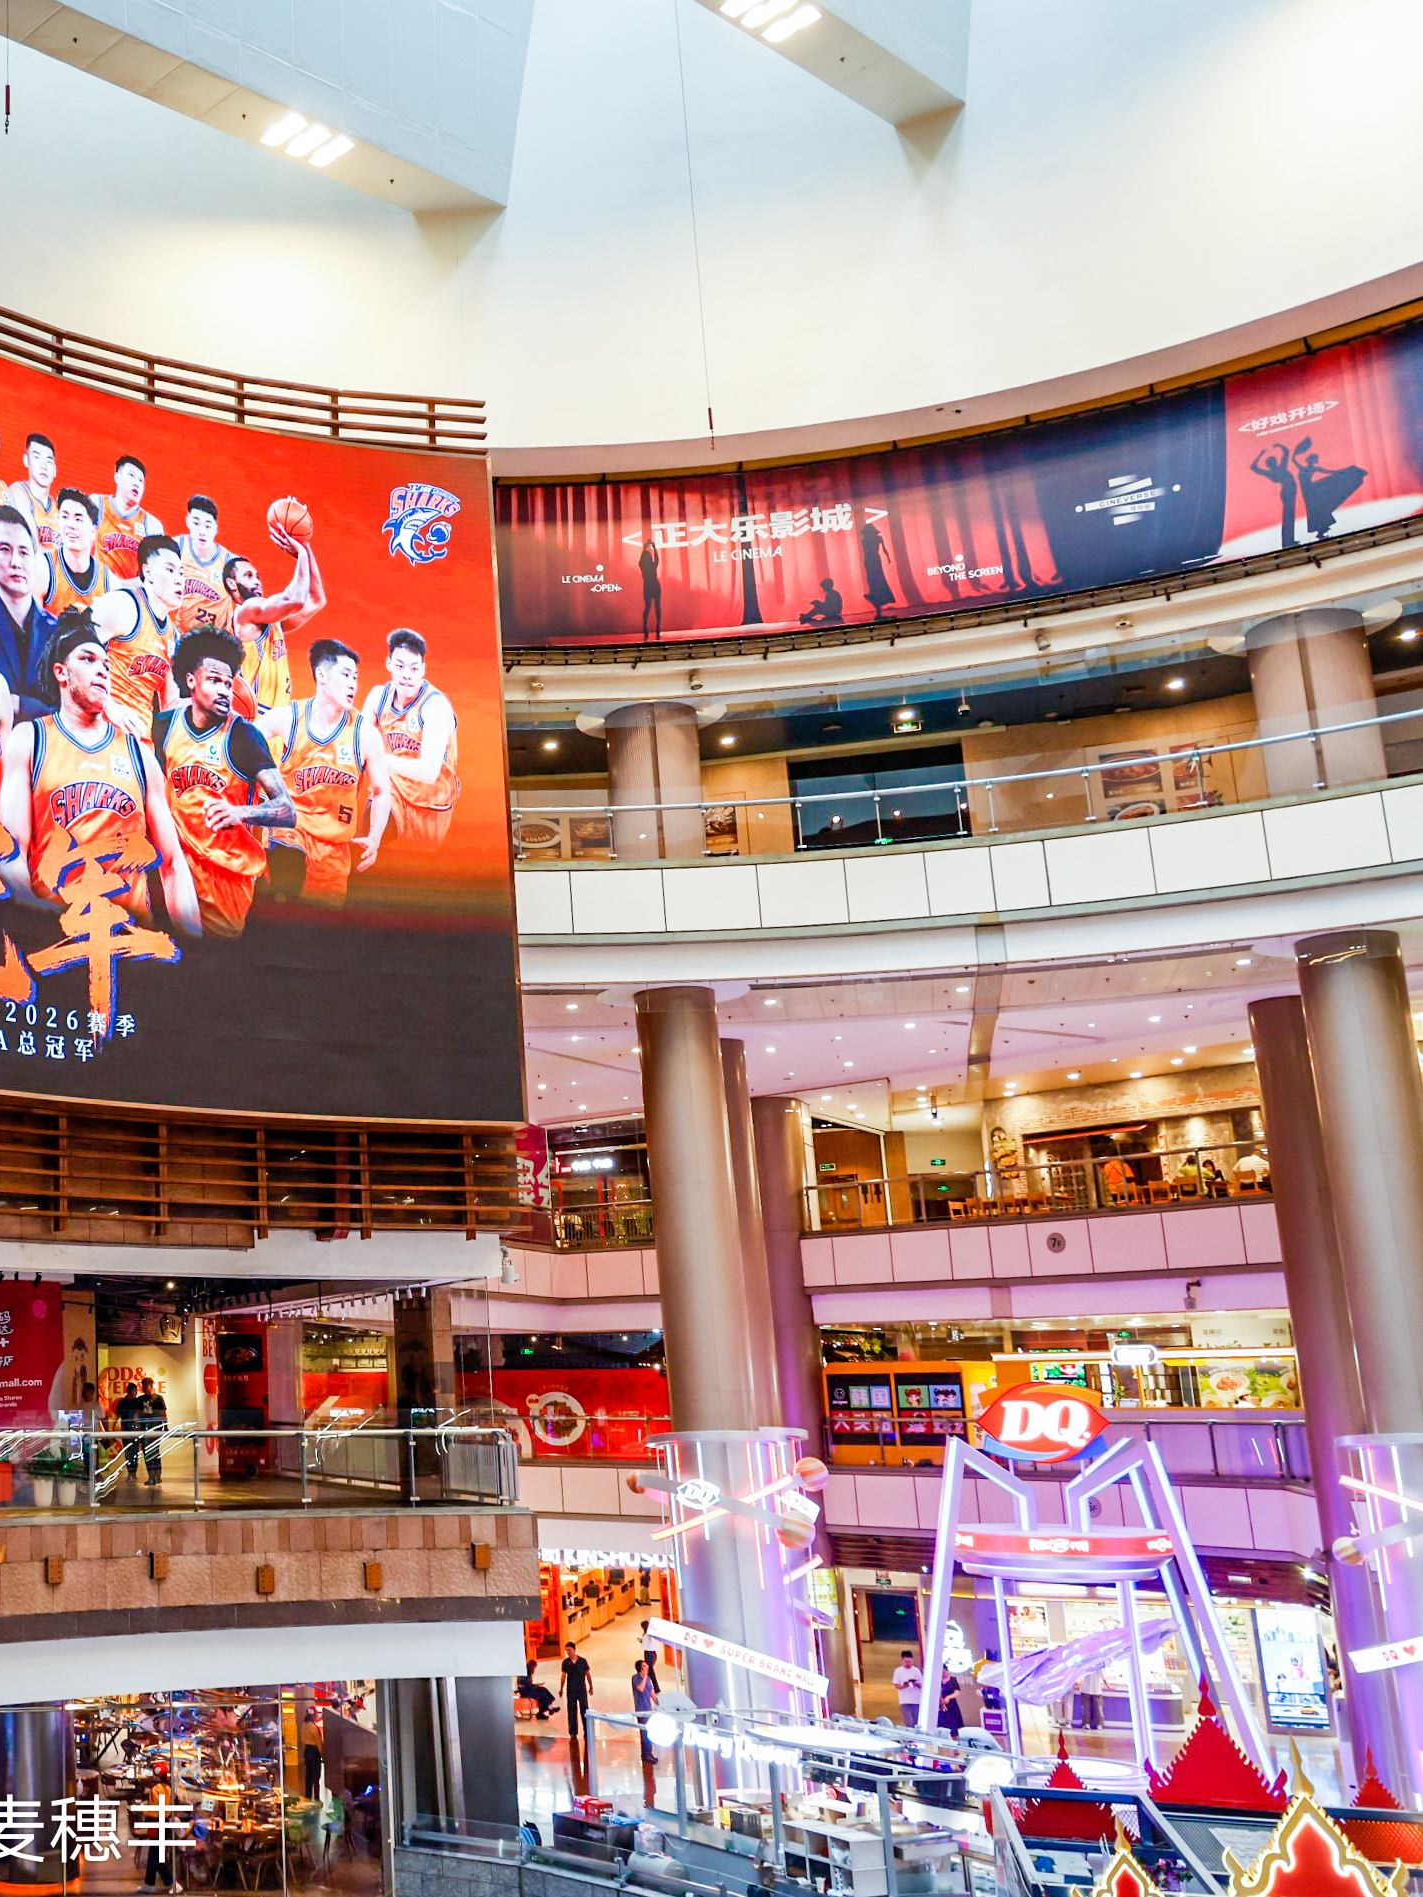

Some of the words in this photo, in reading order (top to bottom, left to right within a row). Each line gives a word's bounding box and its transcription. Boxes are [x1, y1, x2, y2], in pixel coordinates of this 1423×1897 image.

[1098, 489, 1156, 508] CINEVERSE
[650, 503, 853, 549] 正大乐影城
[713, 551, 729, 563] LE
[730, 545, 783, 562] CINEMA
[561, 575, 571, 584] LE
[572, 573, 605, 583] CINEMA
[927, 562, 966, 576] BEYOND
[949, 570, 966, 581] THE
[968, 565, 1004, 579] SCREEN
[593, 583, 620, 593] OPEN
[170, 764, 227, 799] SHARKS
[293, 765, 358, 795] SHARKS
[50, 780, 138, 831] SHARKS
[338, 804, 354, 826] 5
[684, 1631, 698, 1645] DQ
[720, 1645, 756, 1666] SUPER
[759, 1659, 793, 1678] BRAND
